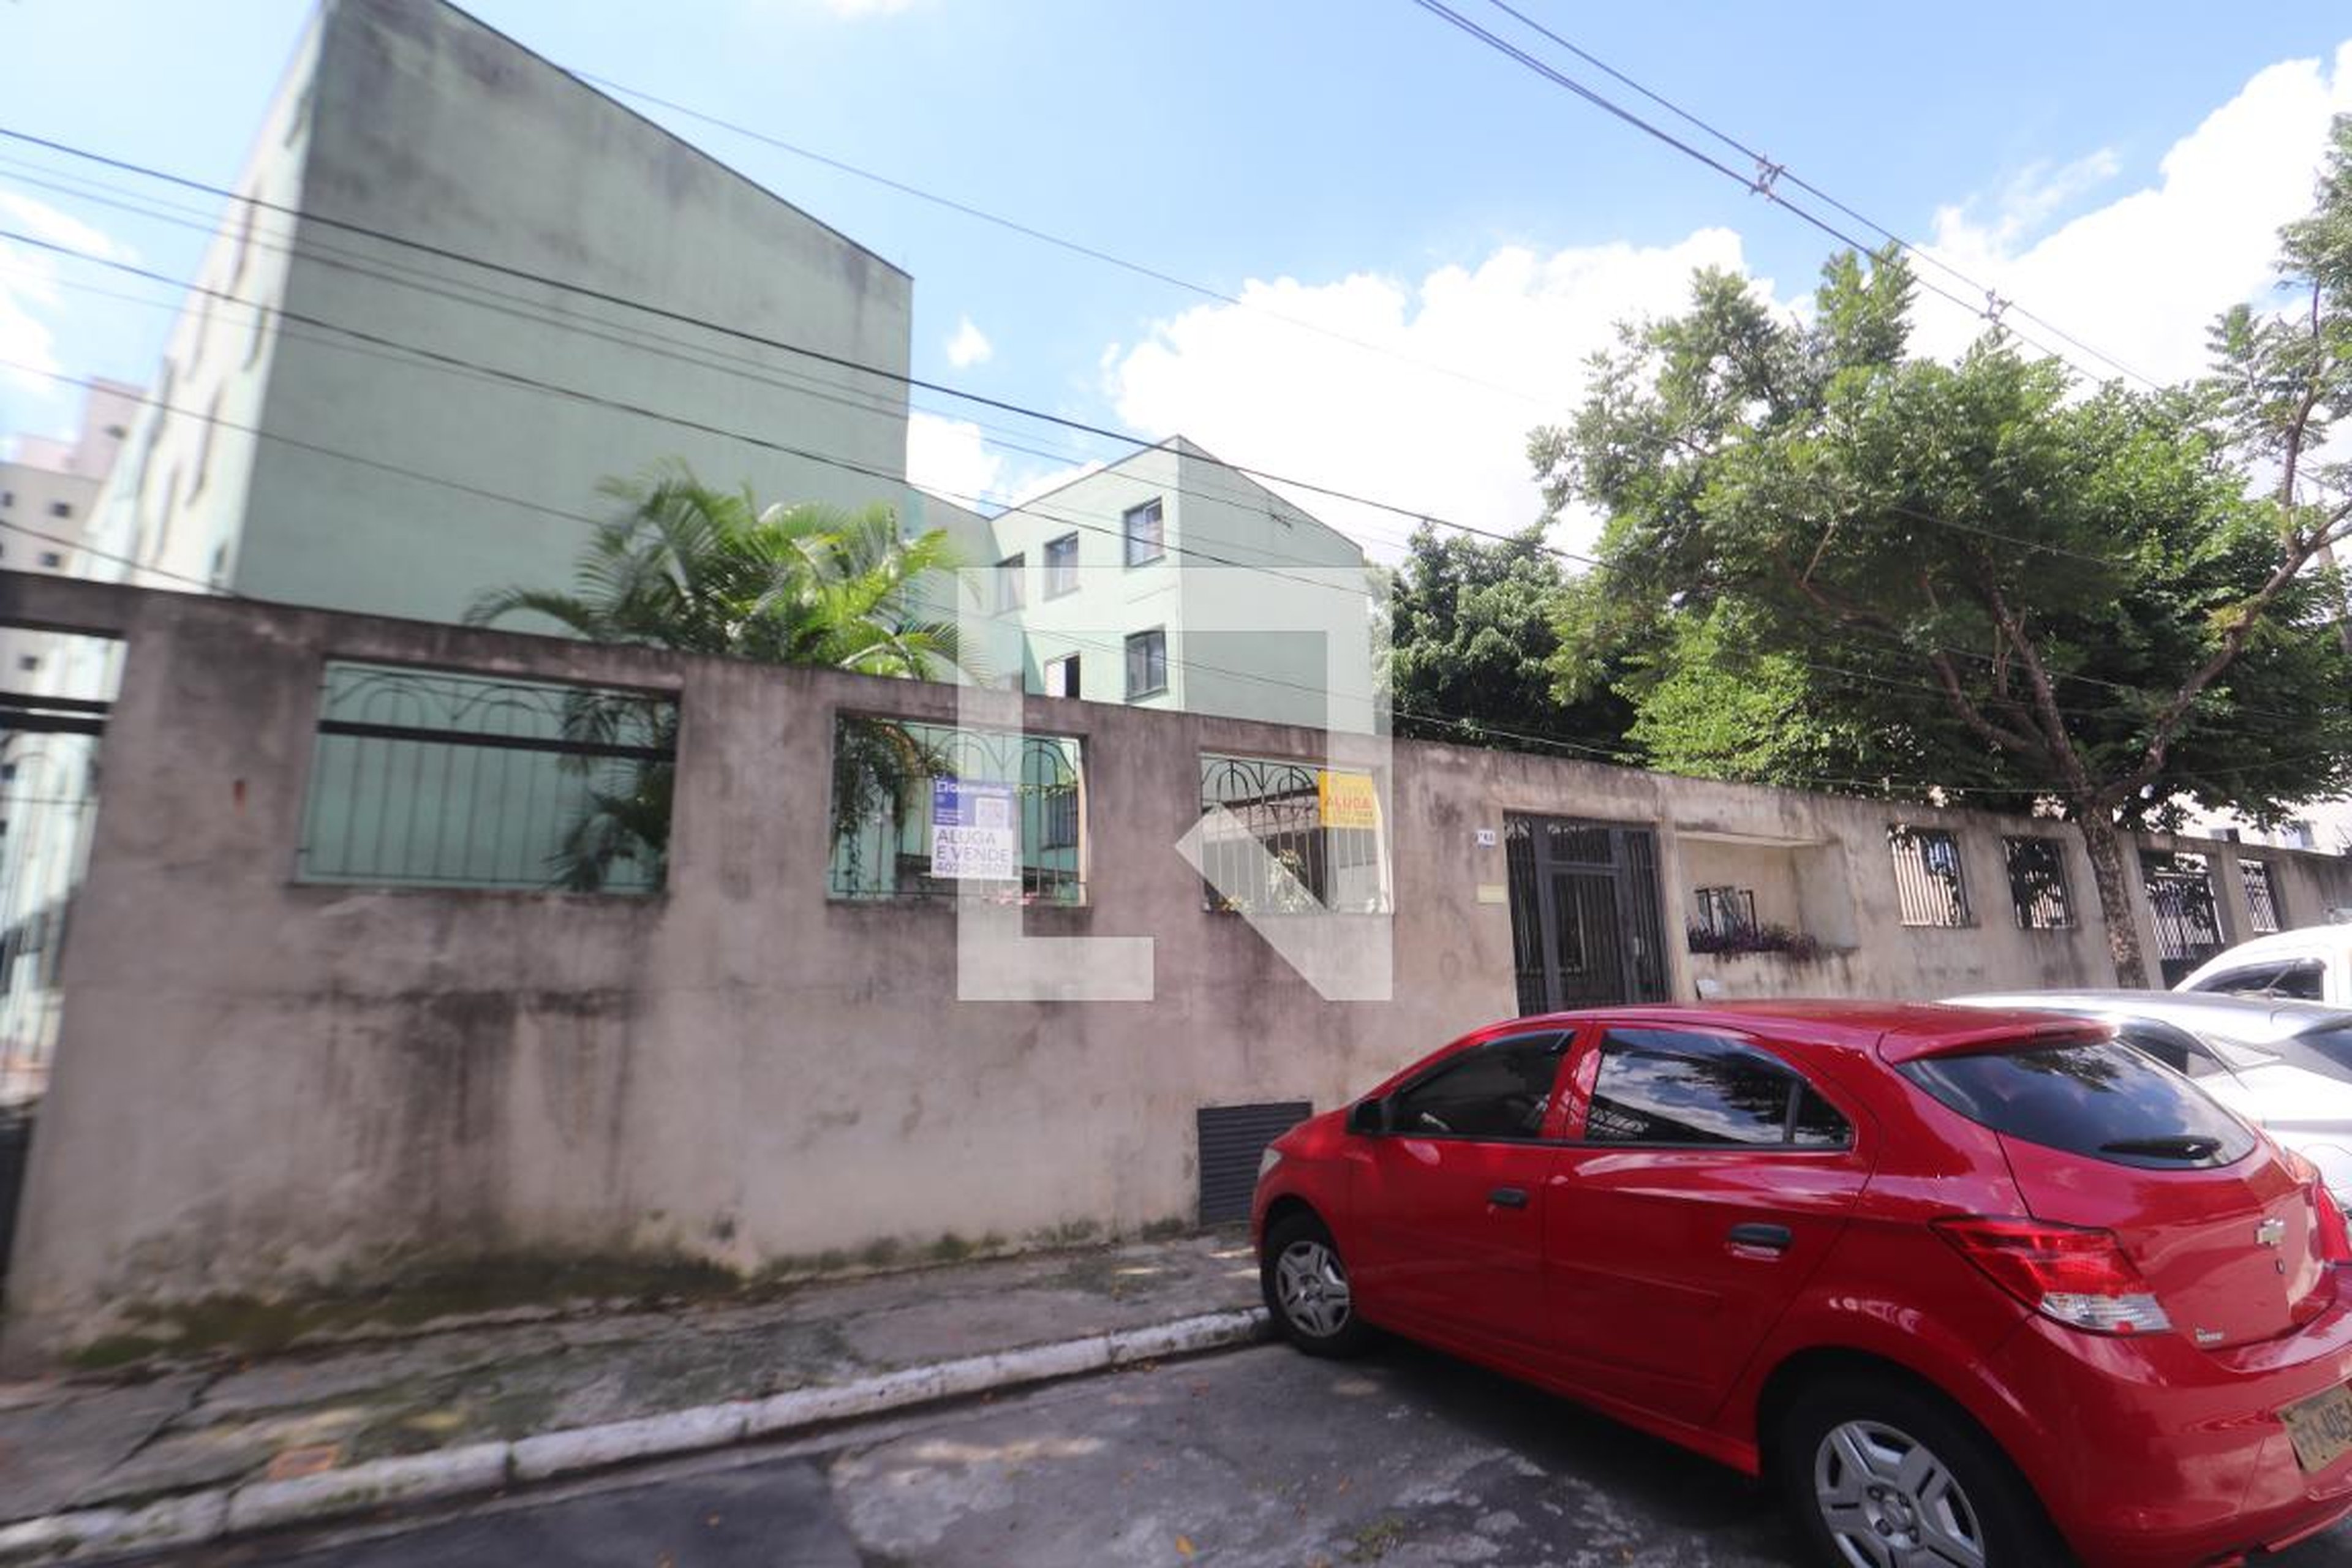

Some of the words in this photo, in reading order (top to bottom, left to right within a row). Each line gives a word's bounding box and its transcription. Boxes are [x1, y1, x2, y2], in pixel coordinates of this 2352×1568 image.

[937, 829, 996, 845] ALUGA
[937, 846, 946, 860] E
[950, 846, 1009, 862] VENDE
